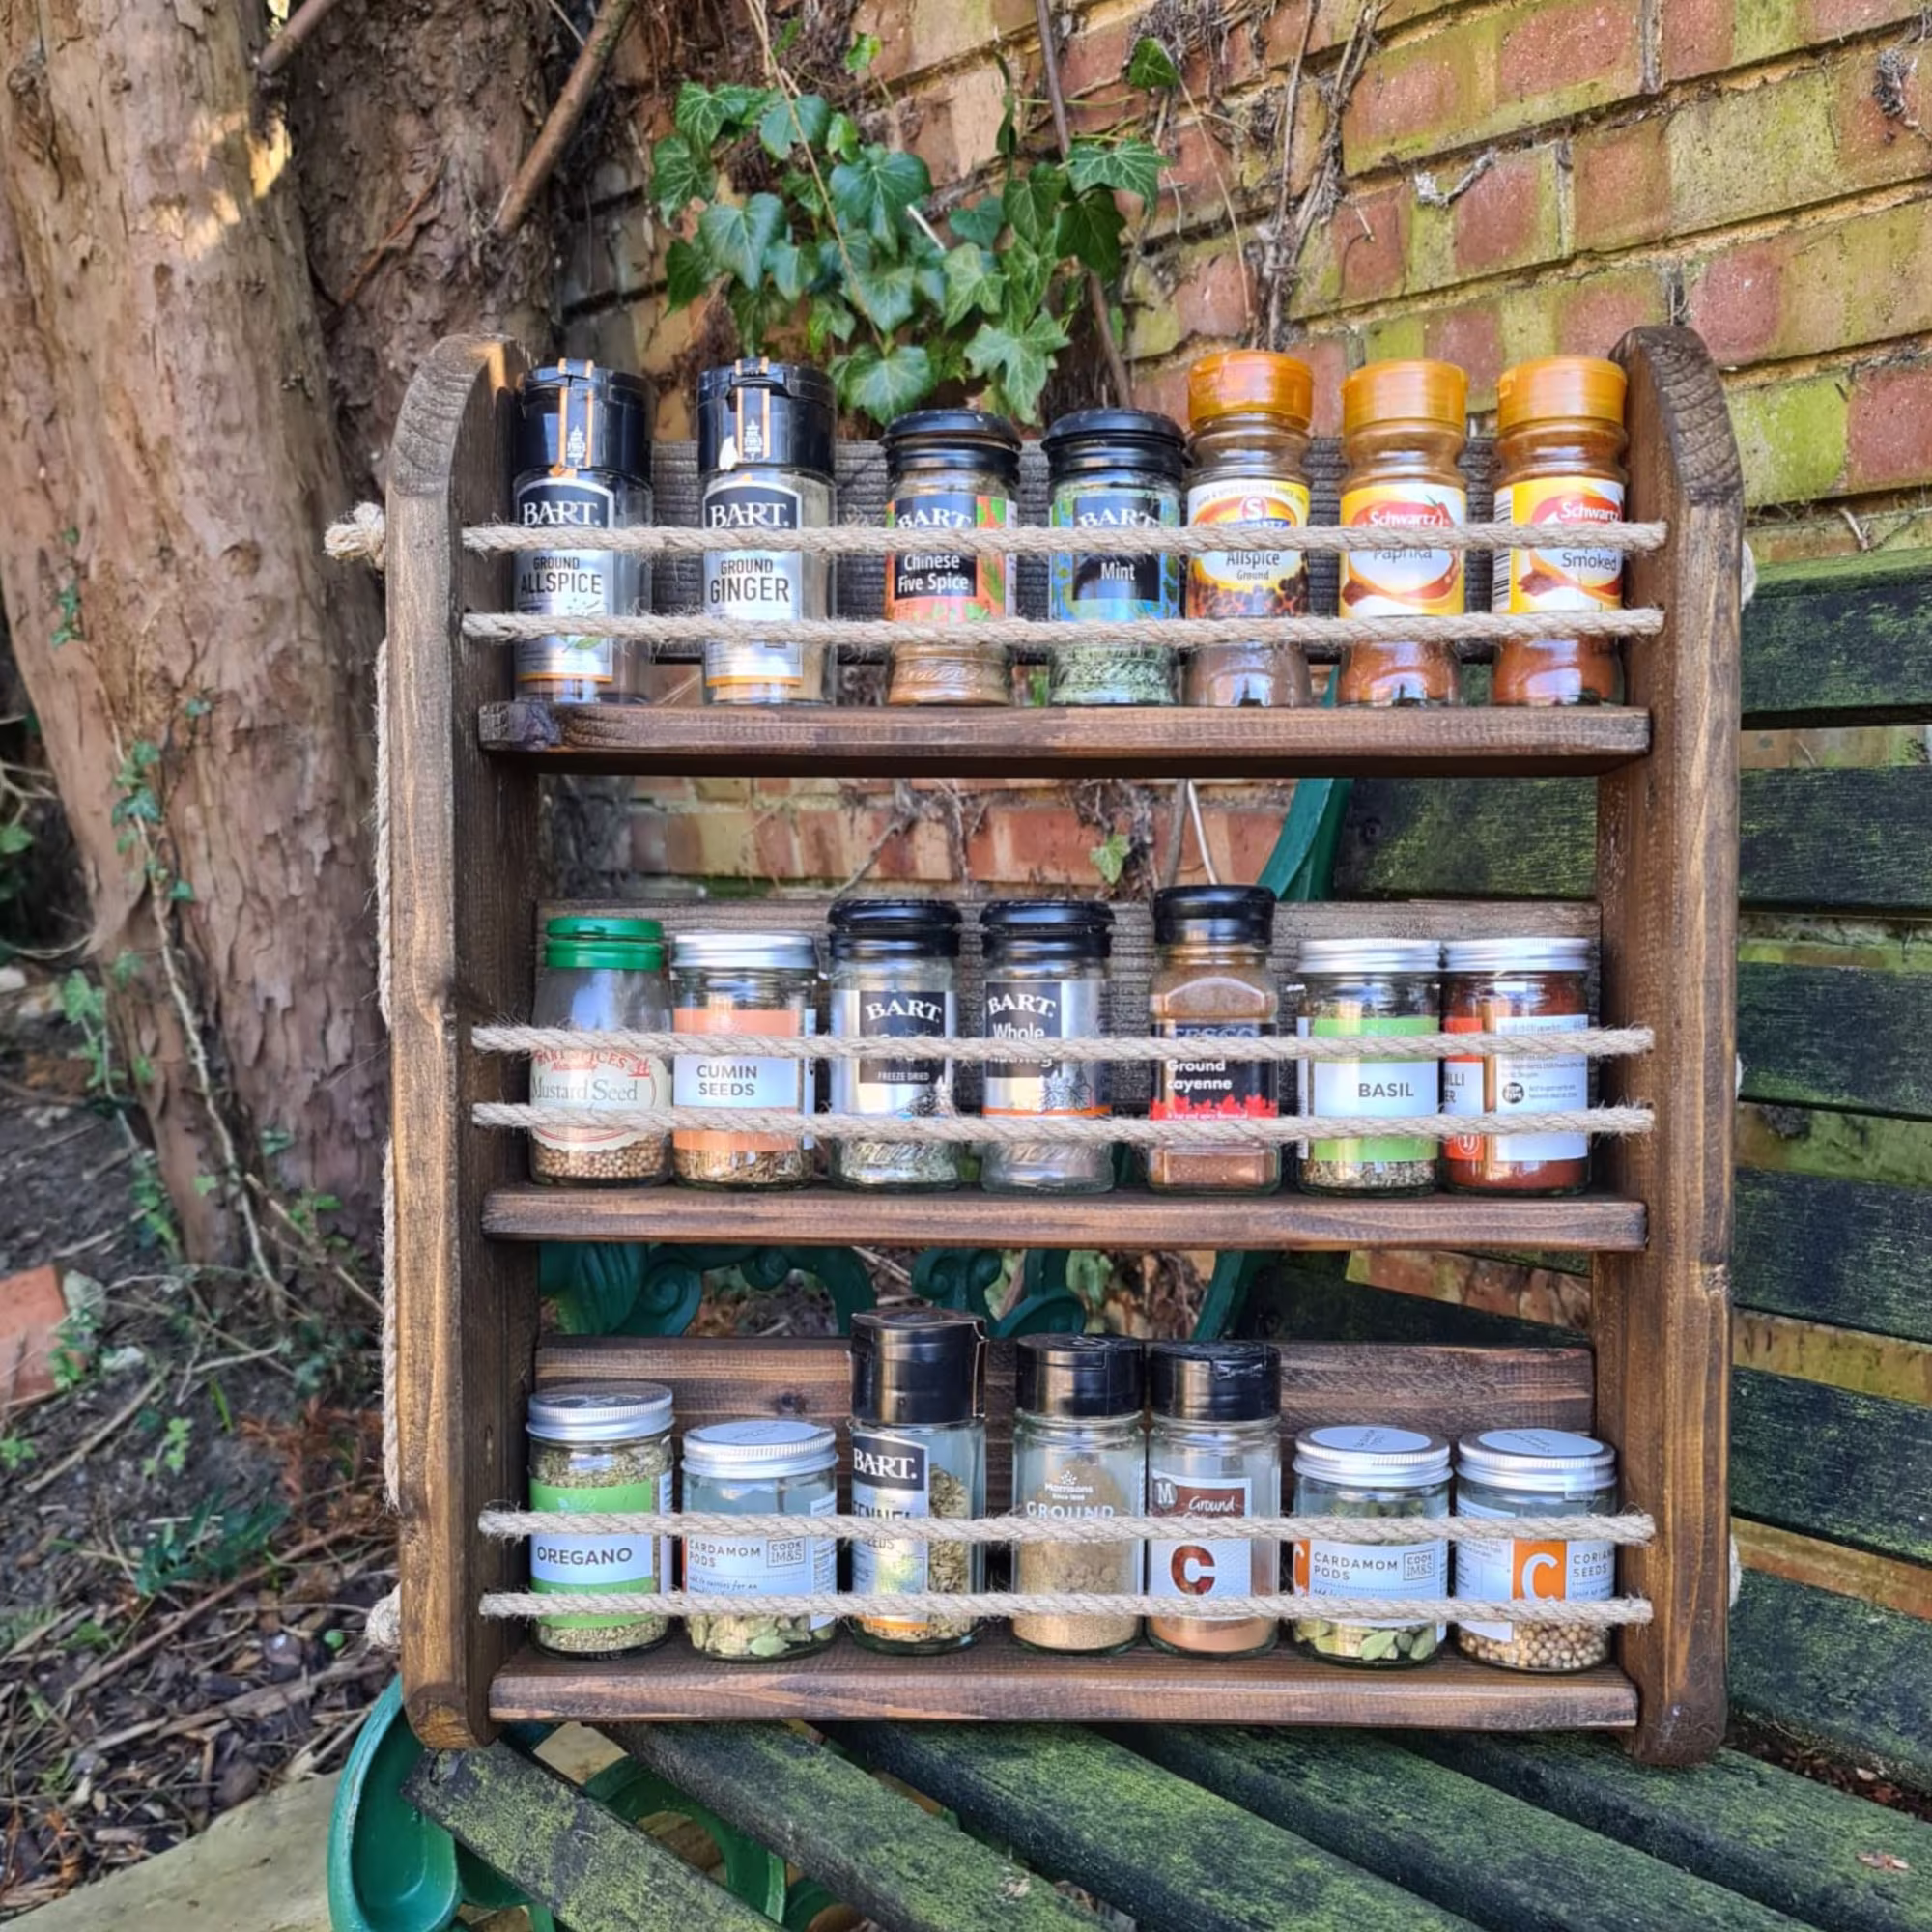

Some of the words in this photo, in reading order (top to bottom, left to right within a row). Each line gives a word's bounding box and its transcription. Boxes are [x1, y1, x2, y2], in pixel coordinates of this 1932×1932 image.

[533, 556, 580, 570] GROUND
[721, 558, 773, 575] GROUND
[904, 553, 960, 571] Chinese
[1226, 551, 1280, 569] Allspice
[1561, 552, 1617, 572] Smoked
[1100, 562, 1136, 581] Mint
[1236, 569, 1269, 581] Ground
[520, 572, 603, 595] ALLSPICE
[710, 577, 790, 604] GINGER
[898, 575, 923, 593] Five
[927, 572, 969, 593] Spice
[993, 1023, 1045, 1039] Whole
[696, 1065, 757, 1079] CUMIN
[1166, 1059, 1226, 1072] Ground
[532, 1075, 588, 1099] Mustard
[592, 1079, 638, 1102] Seed
[698, 1082, 755, 1096] SEEDS
[1358, 1083, 1414, 1098] BASIL
[1157, 1483, 1176, 1505] M
[1026, 1501, 1115, 1519] GROUND
[1189, 1495, 1236, 1514] Ground
[537, 1546, 633, 1566] OREGANO
[689, 1539, 761, 1557] CARDAMOM
[689, 1551, 716, 1568] PODS
[1314, 1551, 1398, 1571] CARDAMOM
[1171, 1544, 1216, 1596] C
[1314, 1565, 1350, 1580] PODS
[1521, 1552, 1559, 1602] C
[1573, 1562, 1608, 1577] SEEDS
